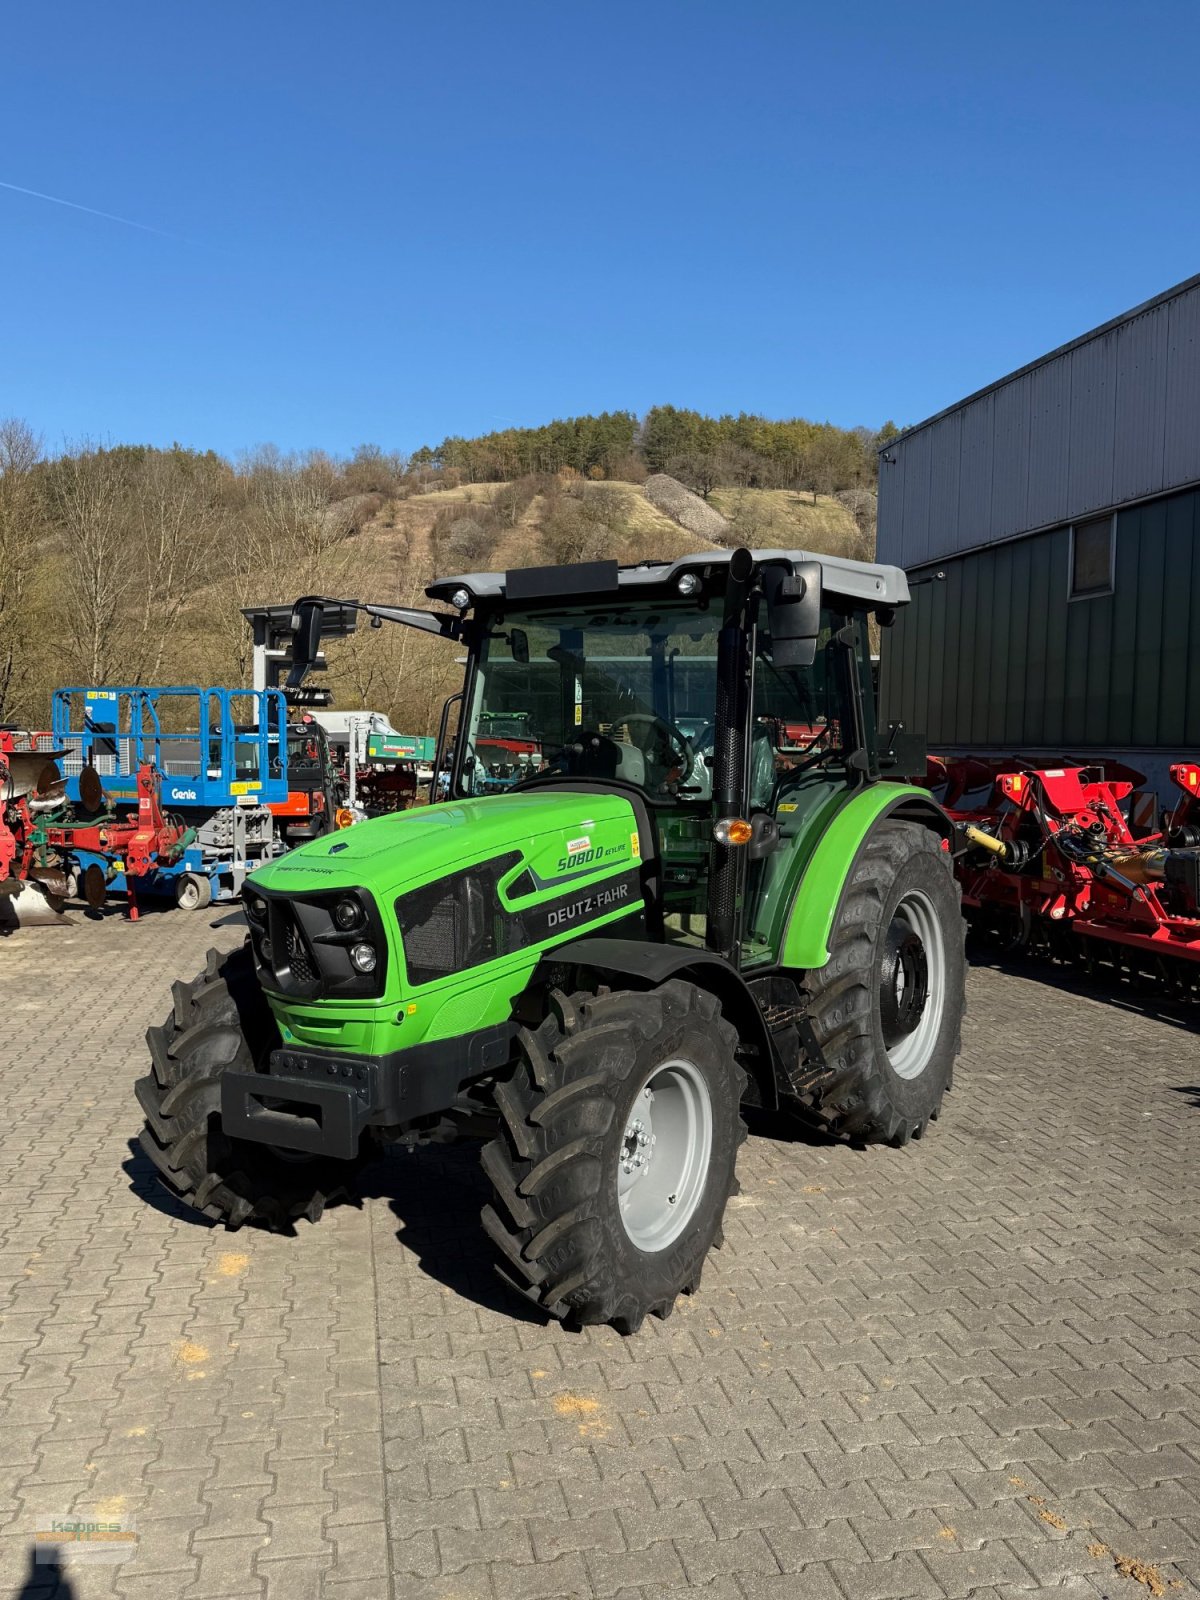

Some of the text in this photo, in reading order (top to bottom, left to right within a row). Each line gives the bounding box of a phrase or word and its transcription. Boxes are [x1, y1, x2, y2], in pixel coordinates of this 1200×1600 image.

[171, 788, 197, 800] Genie
[557, 850, 594, 872] 5080
[596, 847, 604, 859] D
[547, 884, 628, 927] DEUTZ-FAHR
